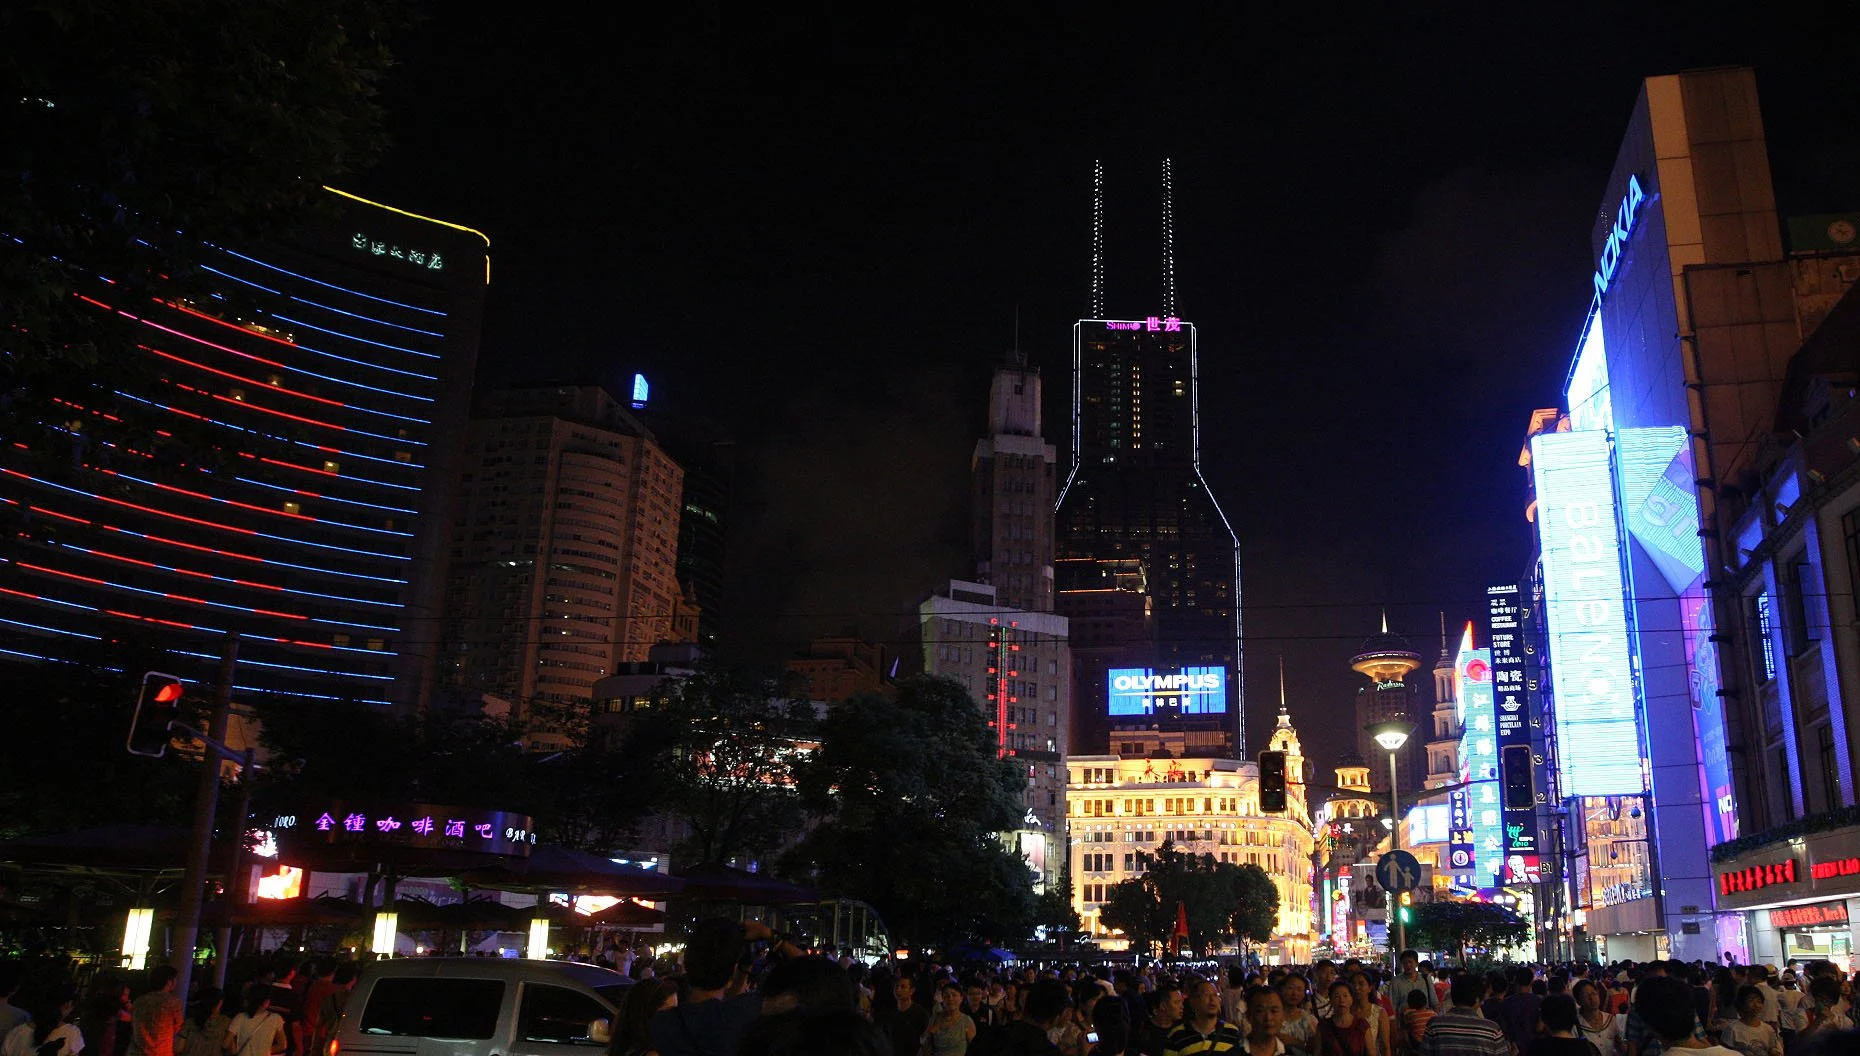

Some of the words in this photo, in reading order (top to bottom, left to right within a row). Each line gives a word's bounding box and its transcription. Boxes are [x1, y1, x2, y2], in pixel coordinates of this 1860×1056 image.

[1594, 174, 1643, 306] NOKIA
[1146, 316, 1181, 332] 世茂
[1522, 608, 1531, 619] 7
[1114, 673, 1220, 690] OLYMPUS
[1496, 670, 1523, 683] 陶瓷
[1528, 680, 1537, 691] 5
[1531, 717, 1541, 728] 4
[1534, 754, 1543, 765] 3
[505, 827, 526, 842] BAR
[1541, 862, 1553, 874] B1
